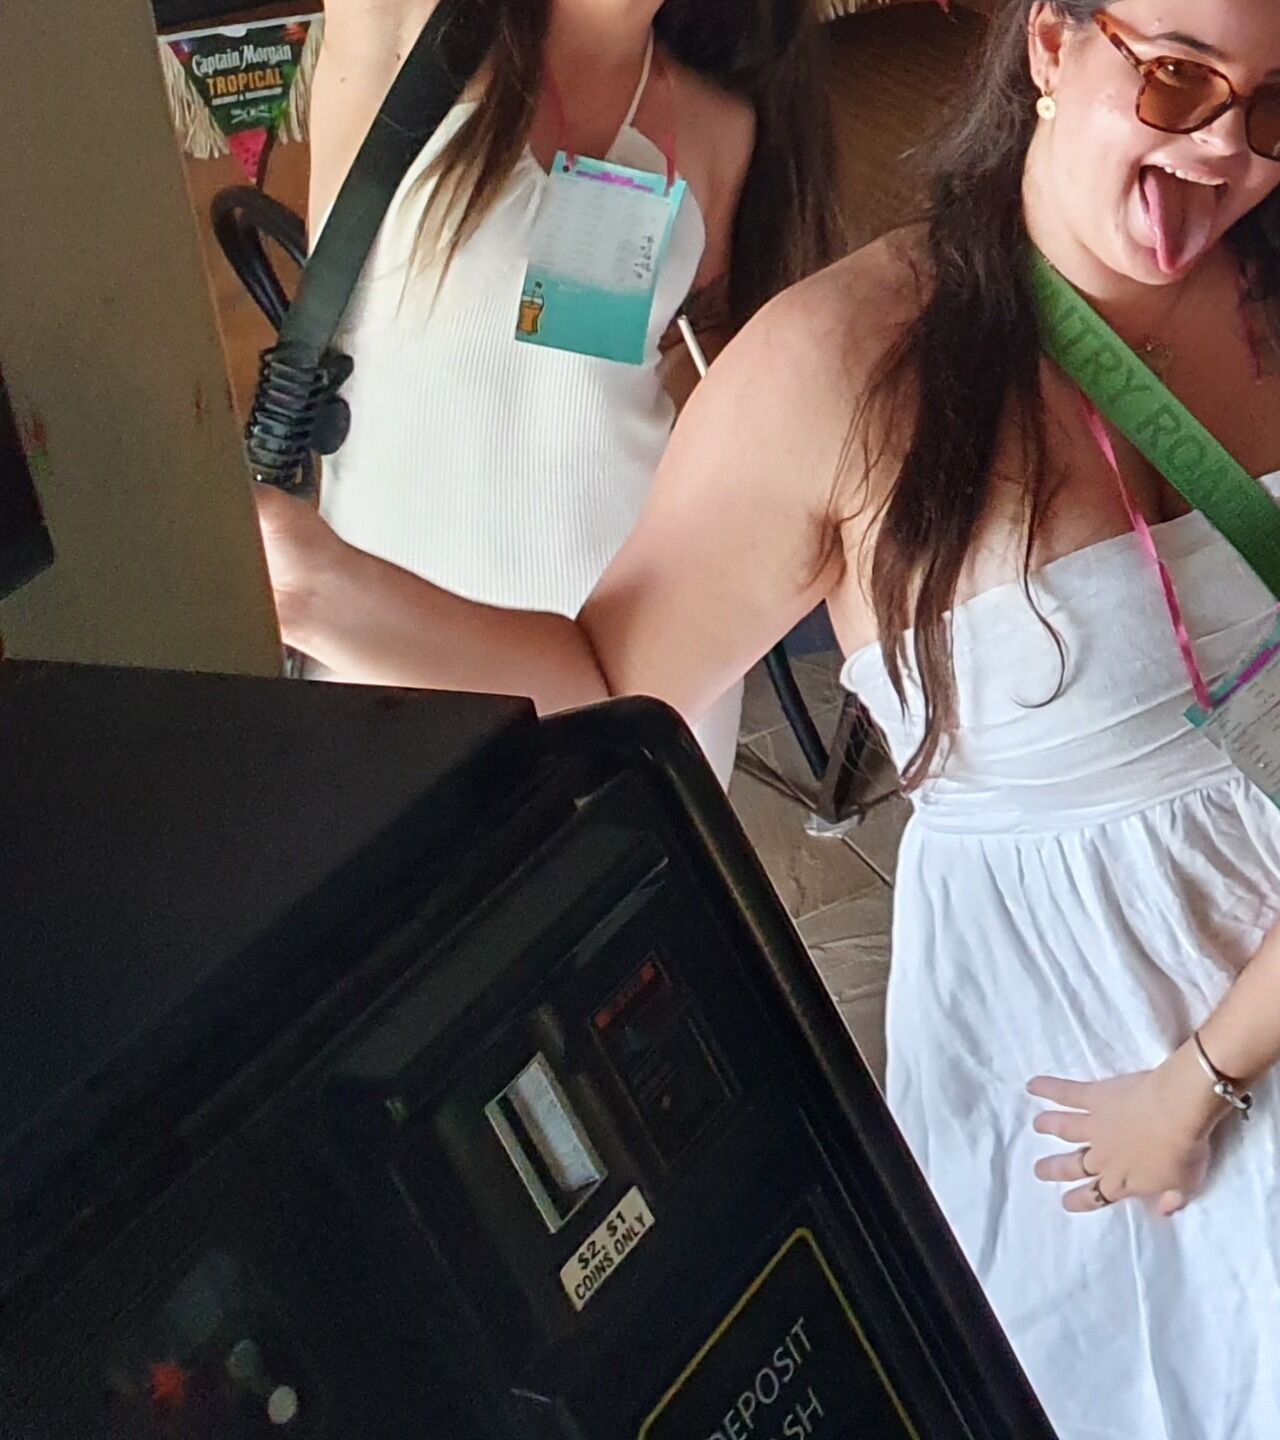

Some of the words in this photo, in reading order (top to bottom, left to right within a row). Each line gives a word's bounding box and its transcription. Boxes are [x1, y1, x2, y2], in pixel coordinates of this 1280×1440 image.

[191, 48, 241, 78] Captain
[238, 44, 292, 71] Morgan
[206, 67, 284, 95] TROPICAL
[574, 1251, 615, 1301] COINS
[613, 1212, 647, 1257] ONLY
[700, 1316, 813, 1440] EPOSIT
